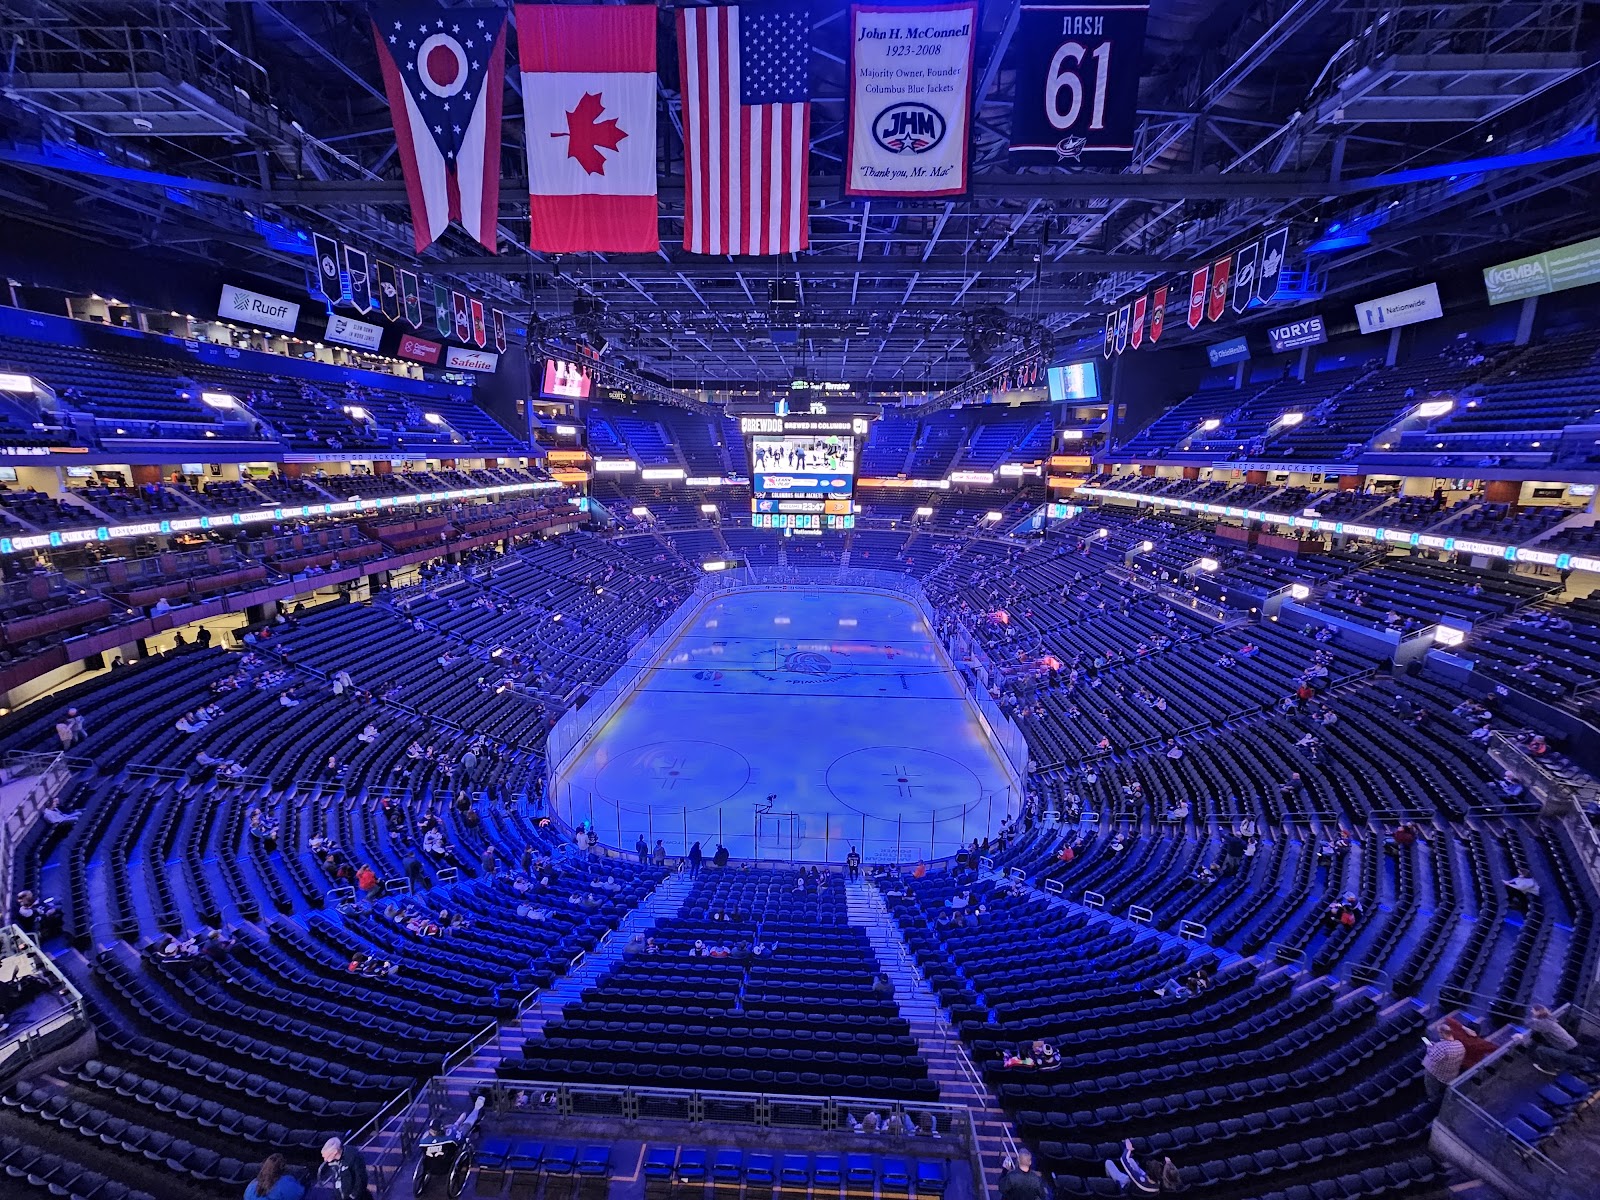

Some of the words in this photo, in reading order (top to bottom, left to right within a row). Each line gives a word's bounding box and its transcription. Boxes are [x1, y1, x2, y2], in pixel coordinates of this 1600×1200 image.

[1062, 16, 1103, 35] NASH
[858, 27, 886, 41] John
[889, 28, 903, 39] H.
[905, 24, 970, 39] McConnell
[886, 44, 942, 56] 1923-2008
[860, 68, 894, 79] Majority
[896, 69, 925, 78] Owner,
[927, 67, 961, 76] Founder
[865, 84, 905, 94] Columbus
[907, 85, 924, 94] Blue
[927, 84, 954, 94] Jackets
[1045, 42, 1111, 130] 61
[882, 112, 936, 139] JHM
[891, 169, 908, 180] you,
[910, 167, 927, 177] Mr.
[1494, 261, 1545, 284] KEMBA
[252, 299, 289, 318] Ruoff
[1386, 298, 1426, 315] Nationwide
[1270, 319, 1322, 341] VORYS
[451, 357, 491, 370] Safelite
[747, 419, 783, 432] BREWDOG
[1275, 464, 1322, 472] JACKETS
[802, 503, 825, 511] 23:47
[1496, 686, 1508, 696] 106
